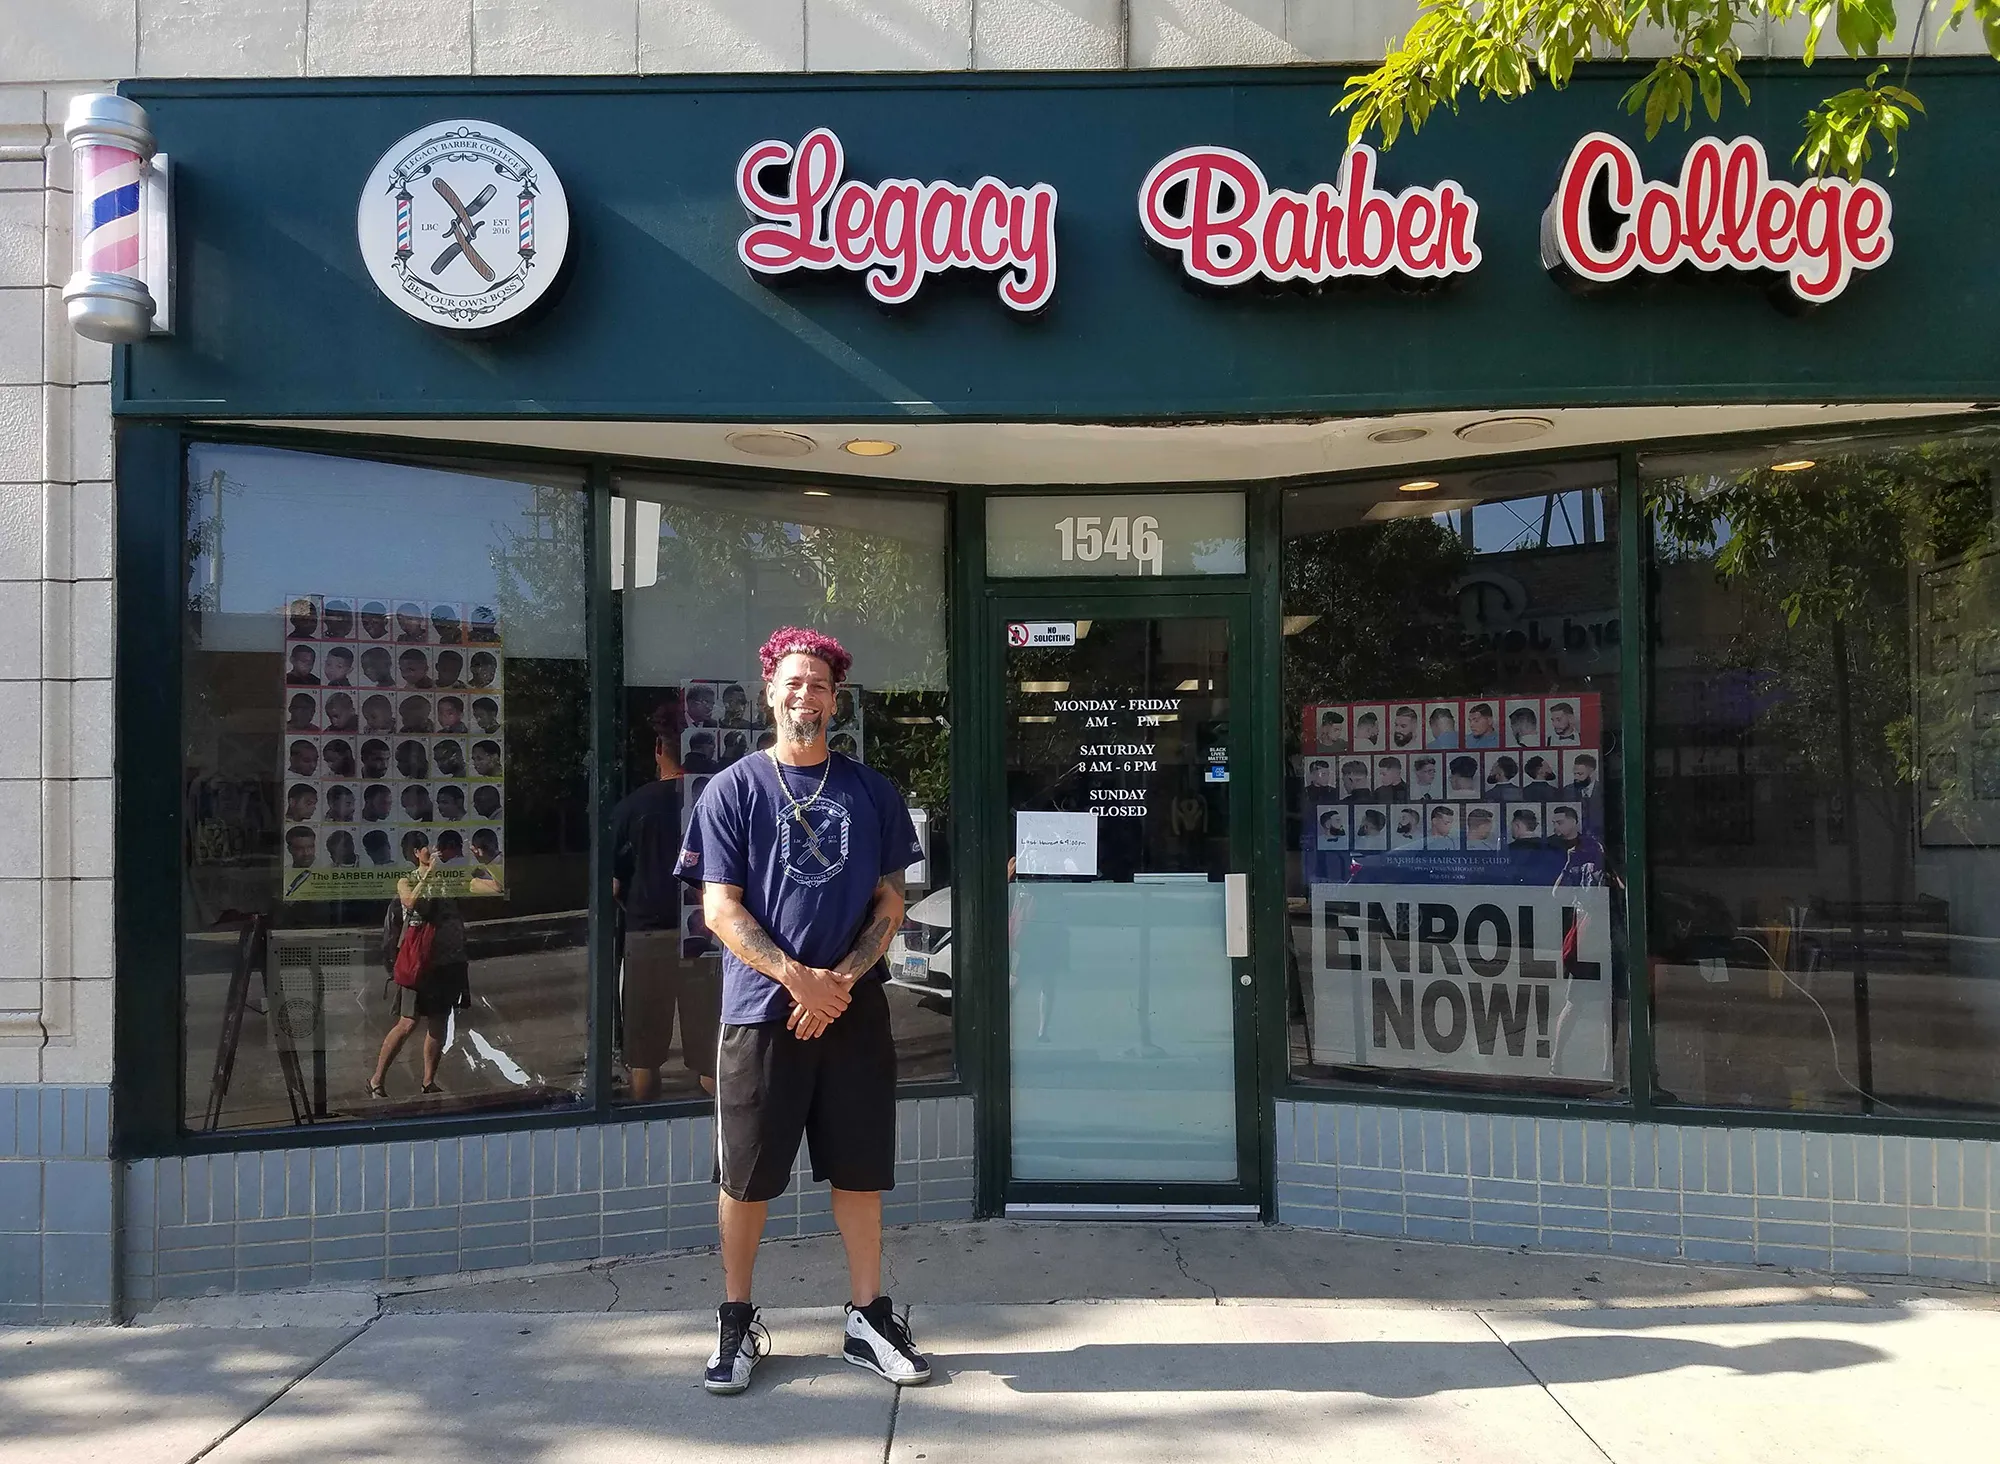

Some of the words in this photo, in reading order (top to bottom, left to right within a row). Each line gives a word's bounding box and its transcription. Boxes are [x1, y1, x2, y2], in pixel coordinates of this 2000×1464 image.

[404, 145, 440, 170] LEGACY
[440, 140, 478, 151] BARBER
[479, 143, 520, 171] COLLEGE
[739, 129, 1056, 308] Legacy
[1142, 146, 1478, 282] Barber
[1559, 135, 1890, 300] College
[421, 223, 439, 231] LBC
[492, 227, 510, 235] 2016
[407, 281, 421, 296] BE
[424, 291, 456, 307] YOUR
[458, 295, 488, 308] OWN
[490, 282, 518, 302] BOSS
[1054, 515, 1160, 562] 1546
[1047, 626, 1057, 635] NO
[1033, 634, 1071, 643] SOLICITING
[1054, 700, 1118, 711] MONDAY
[1128, 699, 1181, 711] FRIDAY
[1085, 716, 1109, 727] AM
[1137, 716, 1160, 727] PM
[1080, 744, 1156, 756] SATURDAY
[1078, 762, 1086, 772] 8
[1089, 761, 1112, 772] AM
[1123, 761, 1131, 772] 6
[1134, 761, 1157, 772] PM
[1089, 789, 1147, 801] SUNDAY
[1089, 806, 1147, 818] CLOSED
[1386, 856, 1427, 865] BARBERS
[1429, 856, 1479, 865] HAIRSTYLE
[1482, 856, 1512, 865] GUIDE
[311, 872, 330, 881] The
[332, 871, 375, 881] BARBER
[435, 870, 466, 879] GUIDE
[1324, 899, 1602, 981] ENROLL
[1371, 977, 1552, 1060] NOW!
